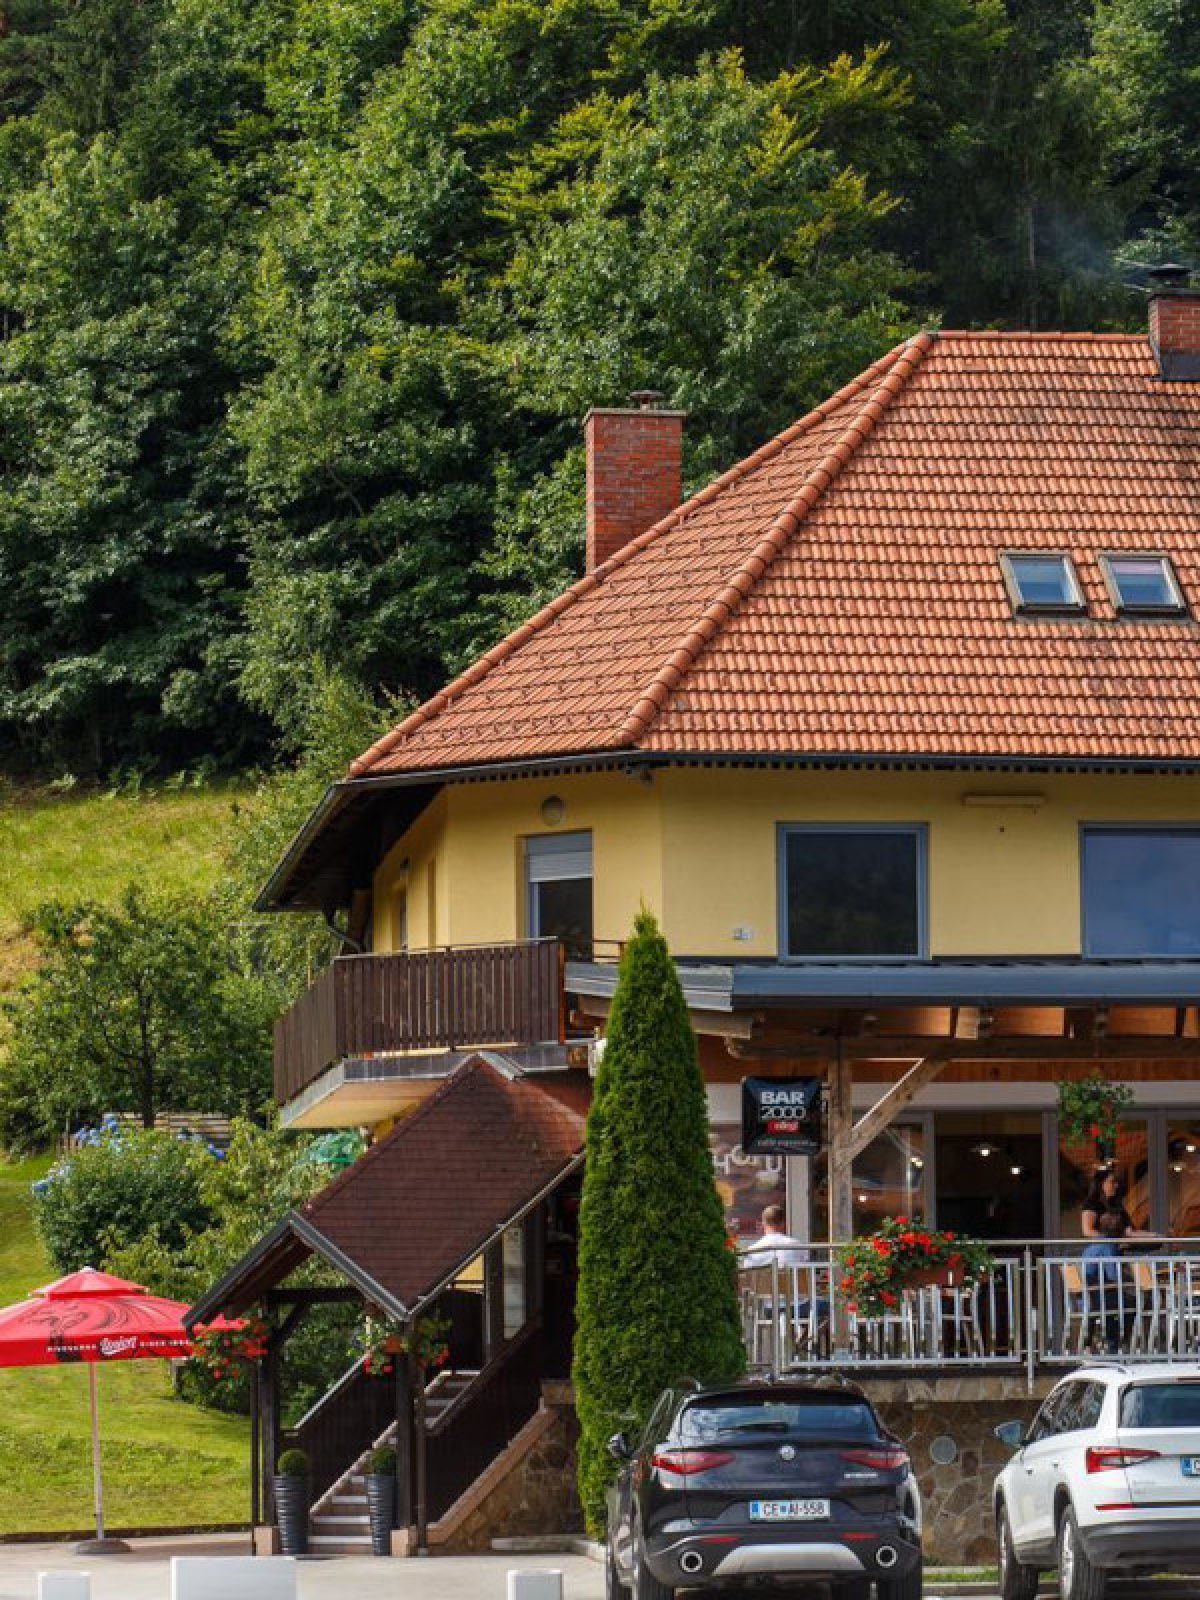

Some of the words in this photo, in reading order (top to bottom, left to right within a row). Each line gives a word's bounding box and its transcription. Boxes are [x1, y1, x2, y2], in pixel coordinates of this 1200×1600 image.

[761, 1091, 805, 1104] BAR
[761, 1105, 807, 1120] 2000
[763, 1502, 779, 1516] CE
